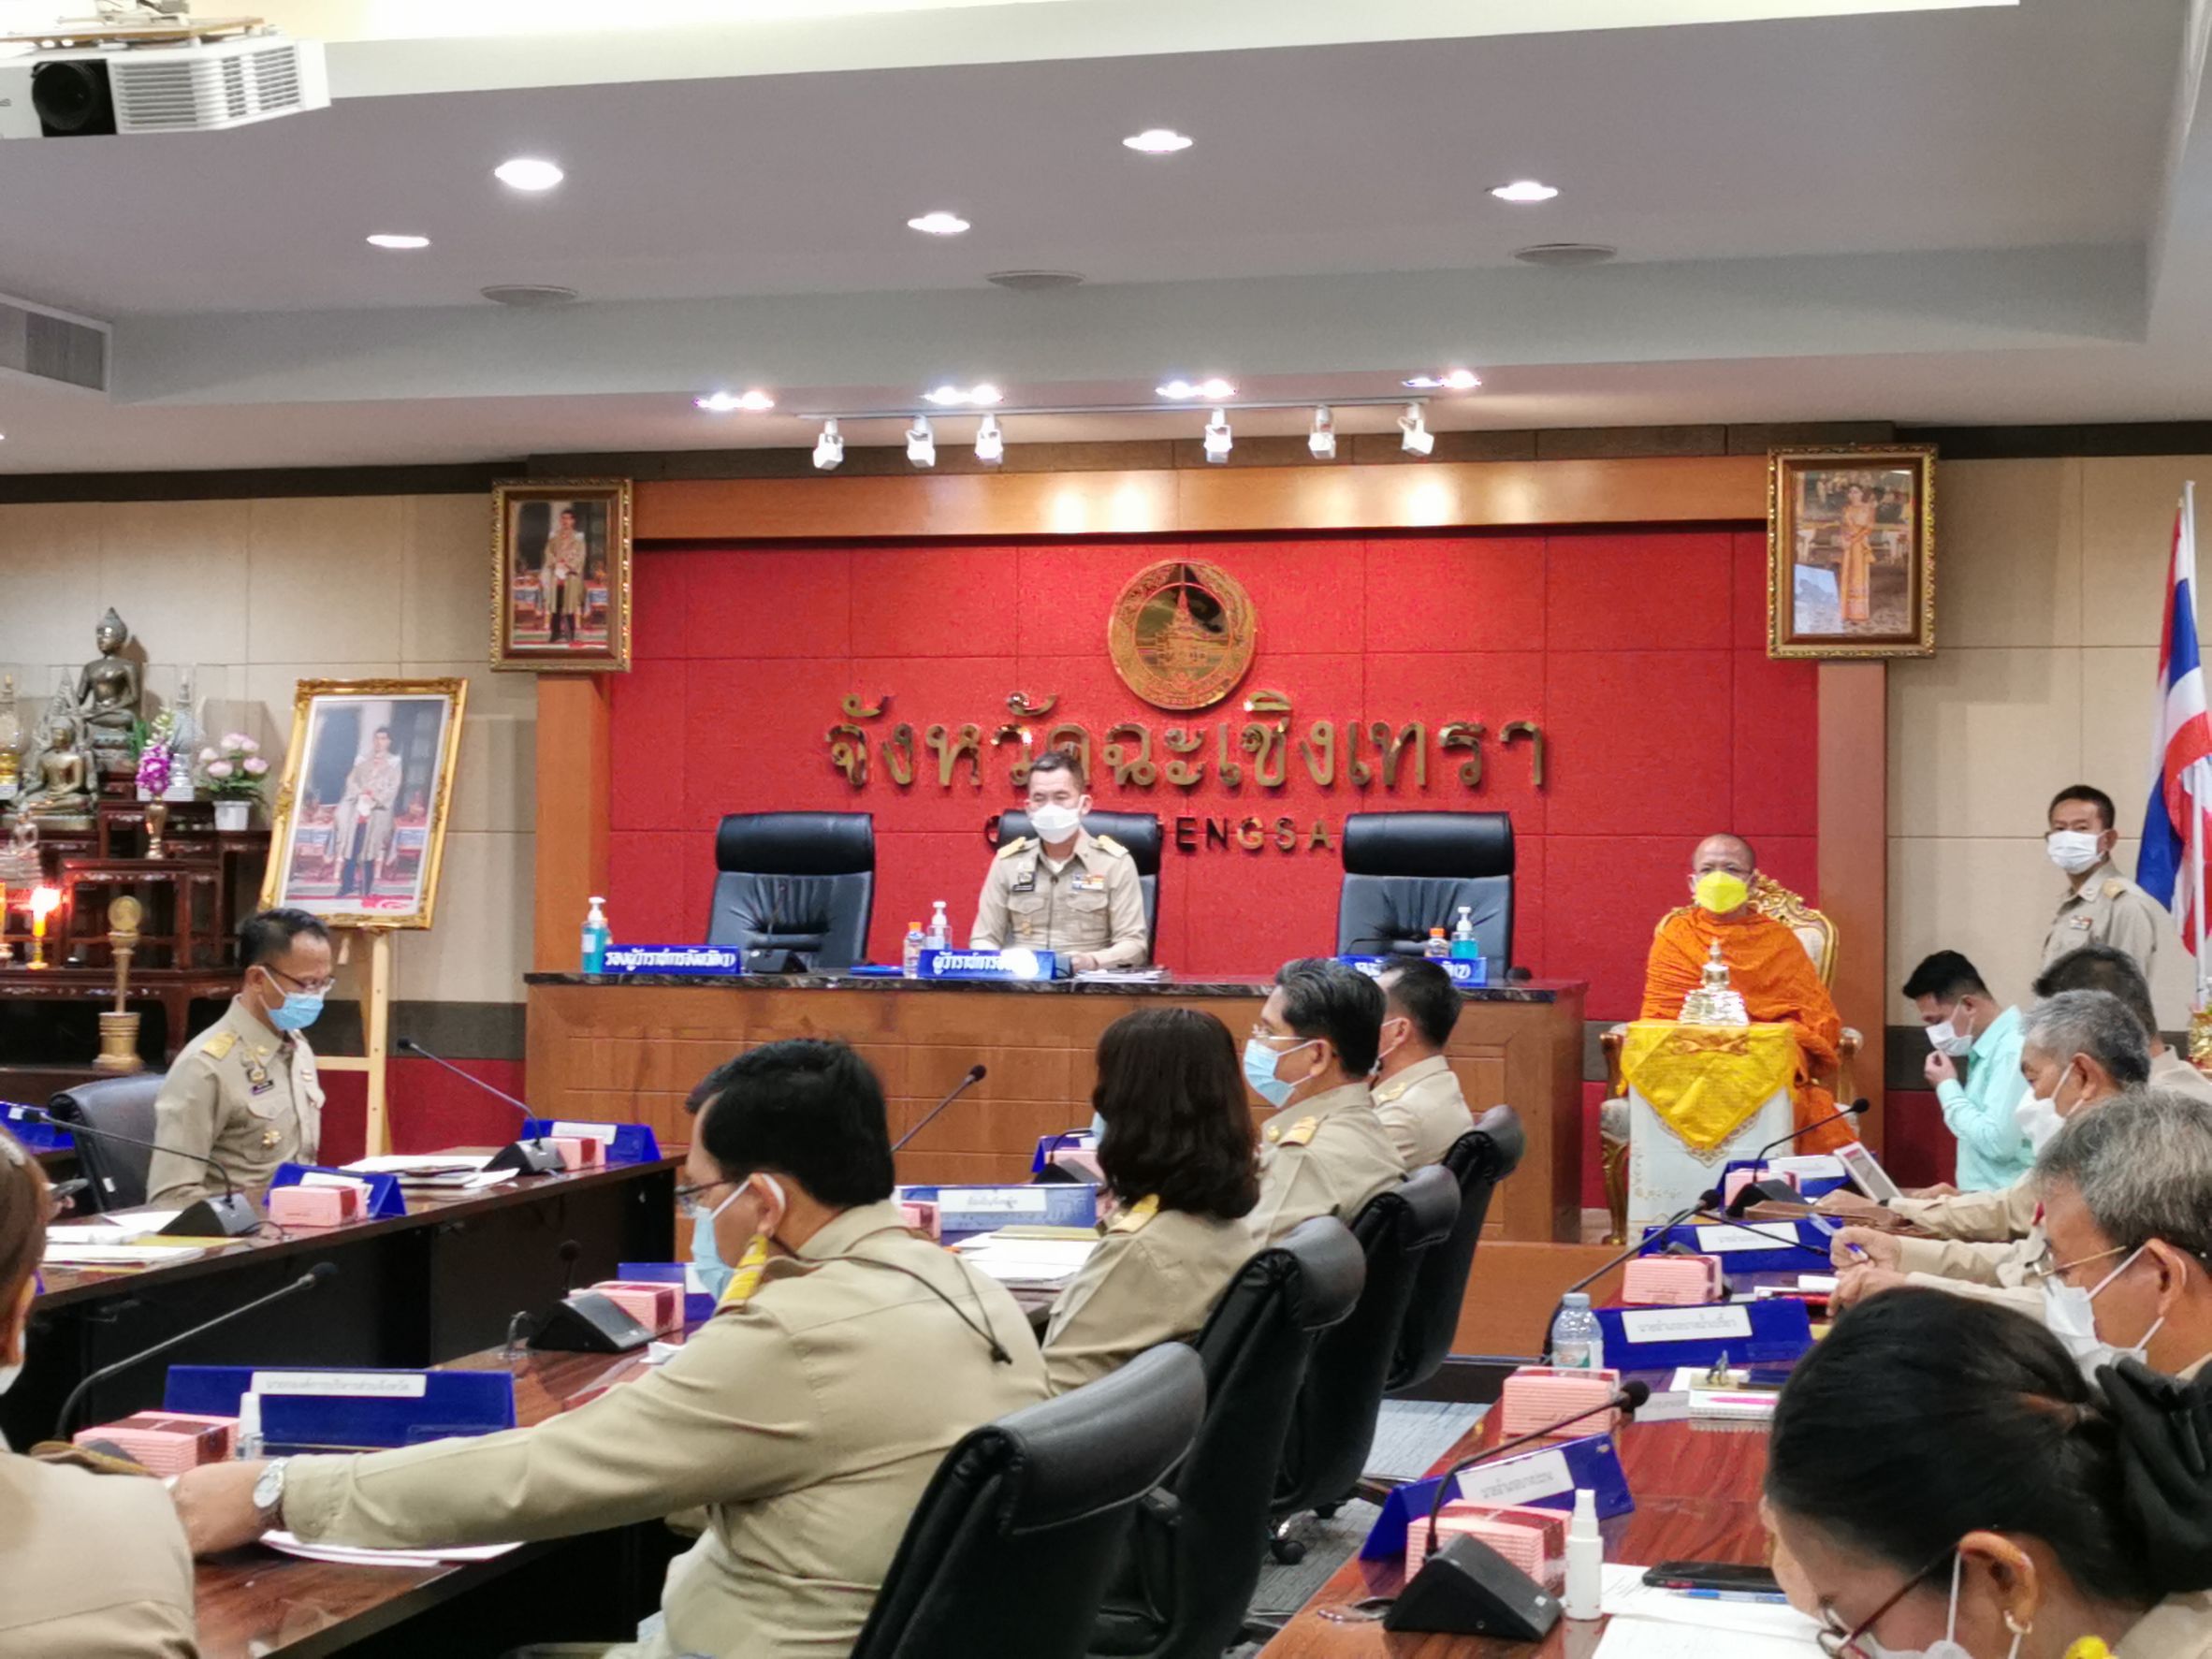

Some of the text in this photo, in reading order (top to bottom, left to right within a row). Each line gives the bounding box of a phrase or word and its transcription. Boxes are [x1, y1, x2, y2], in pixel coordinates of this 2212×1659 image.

[824, 690, 1542, 787] จังหวัดฉะเชิงเทรา
